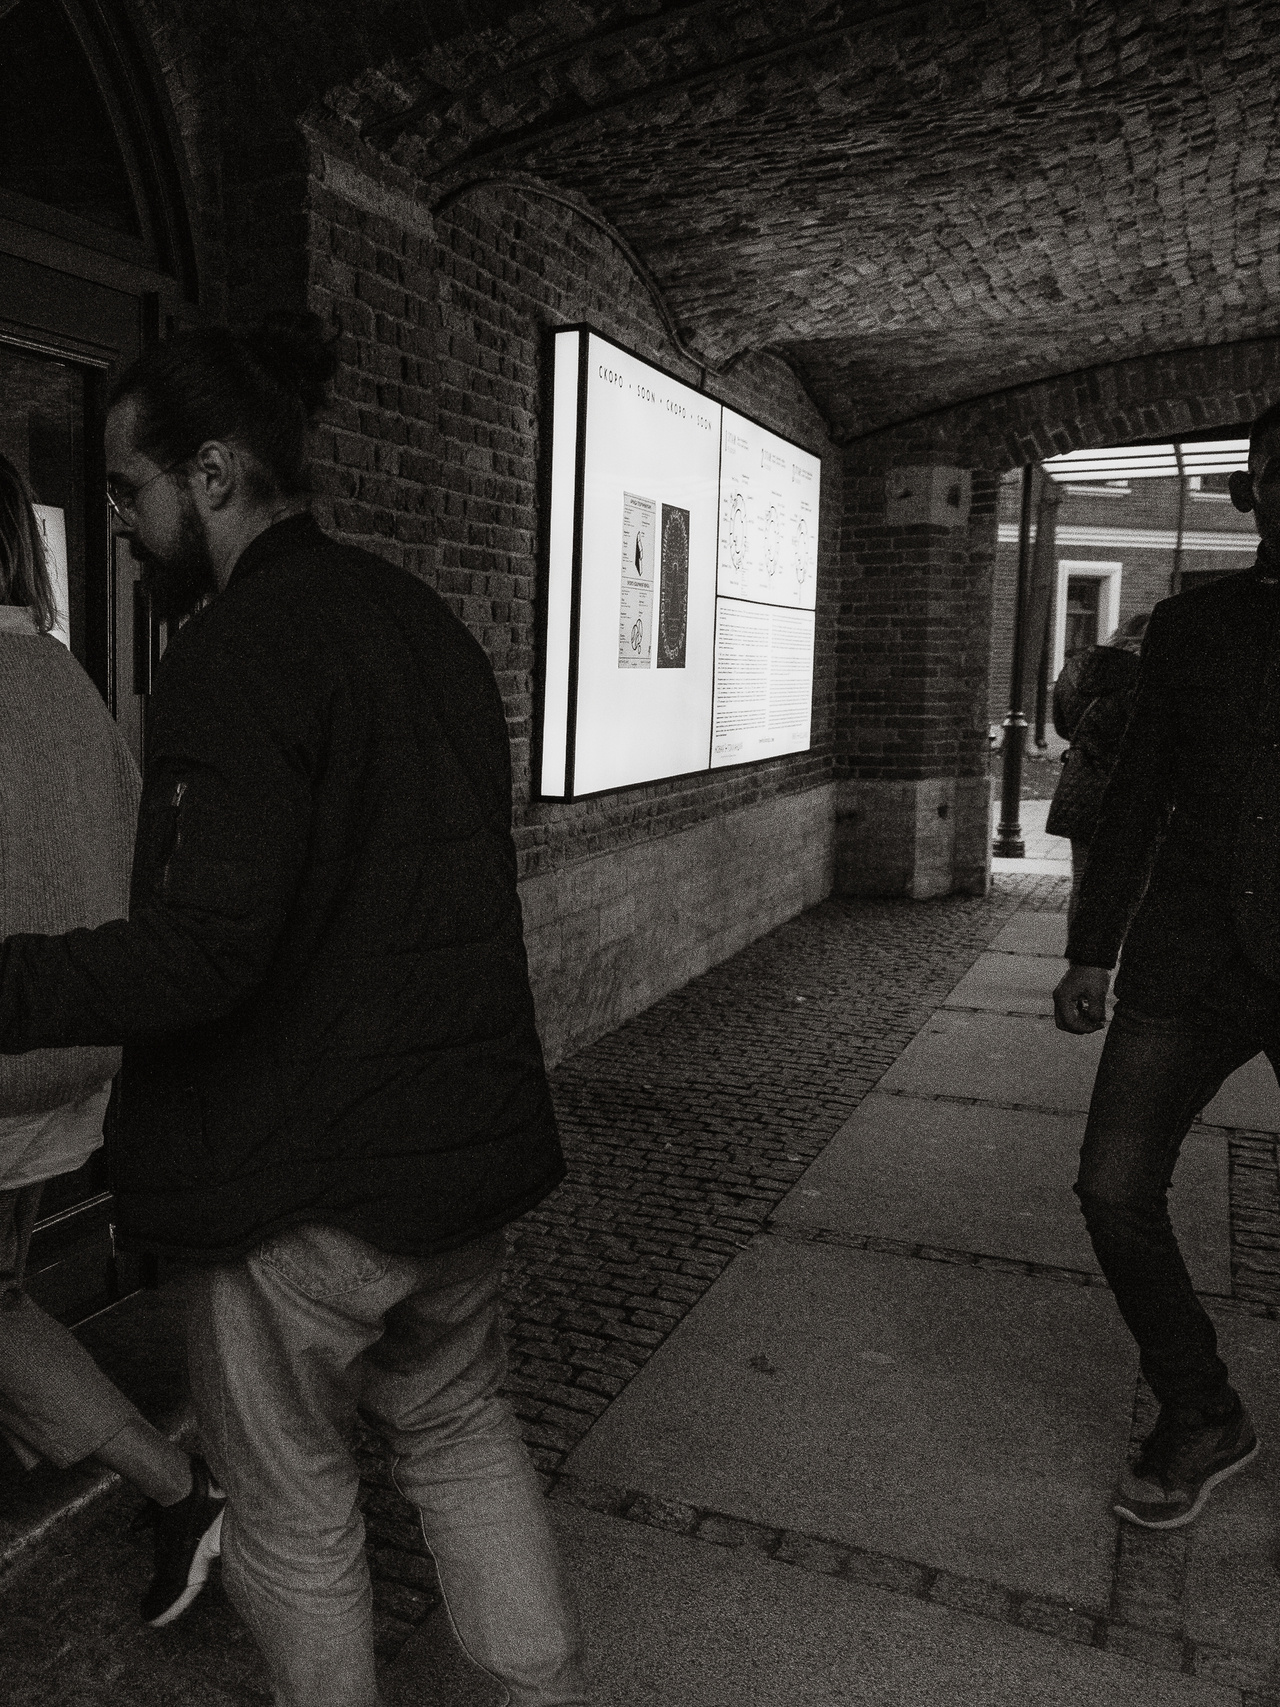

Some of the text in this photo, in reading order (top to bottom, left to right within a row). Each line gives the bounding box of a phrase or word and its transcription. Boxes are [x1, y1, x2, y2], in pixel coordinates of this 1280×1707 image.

[598, 365, 712, 431] СКОРО SOON СКОРО SOON
